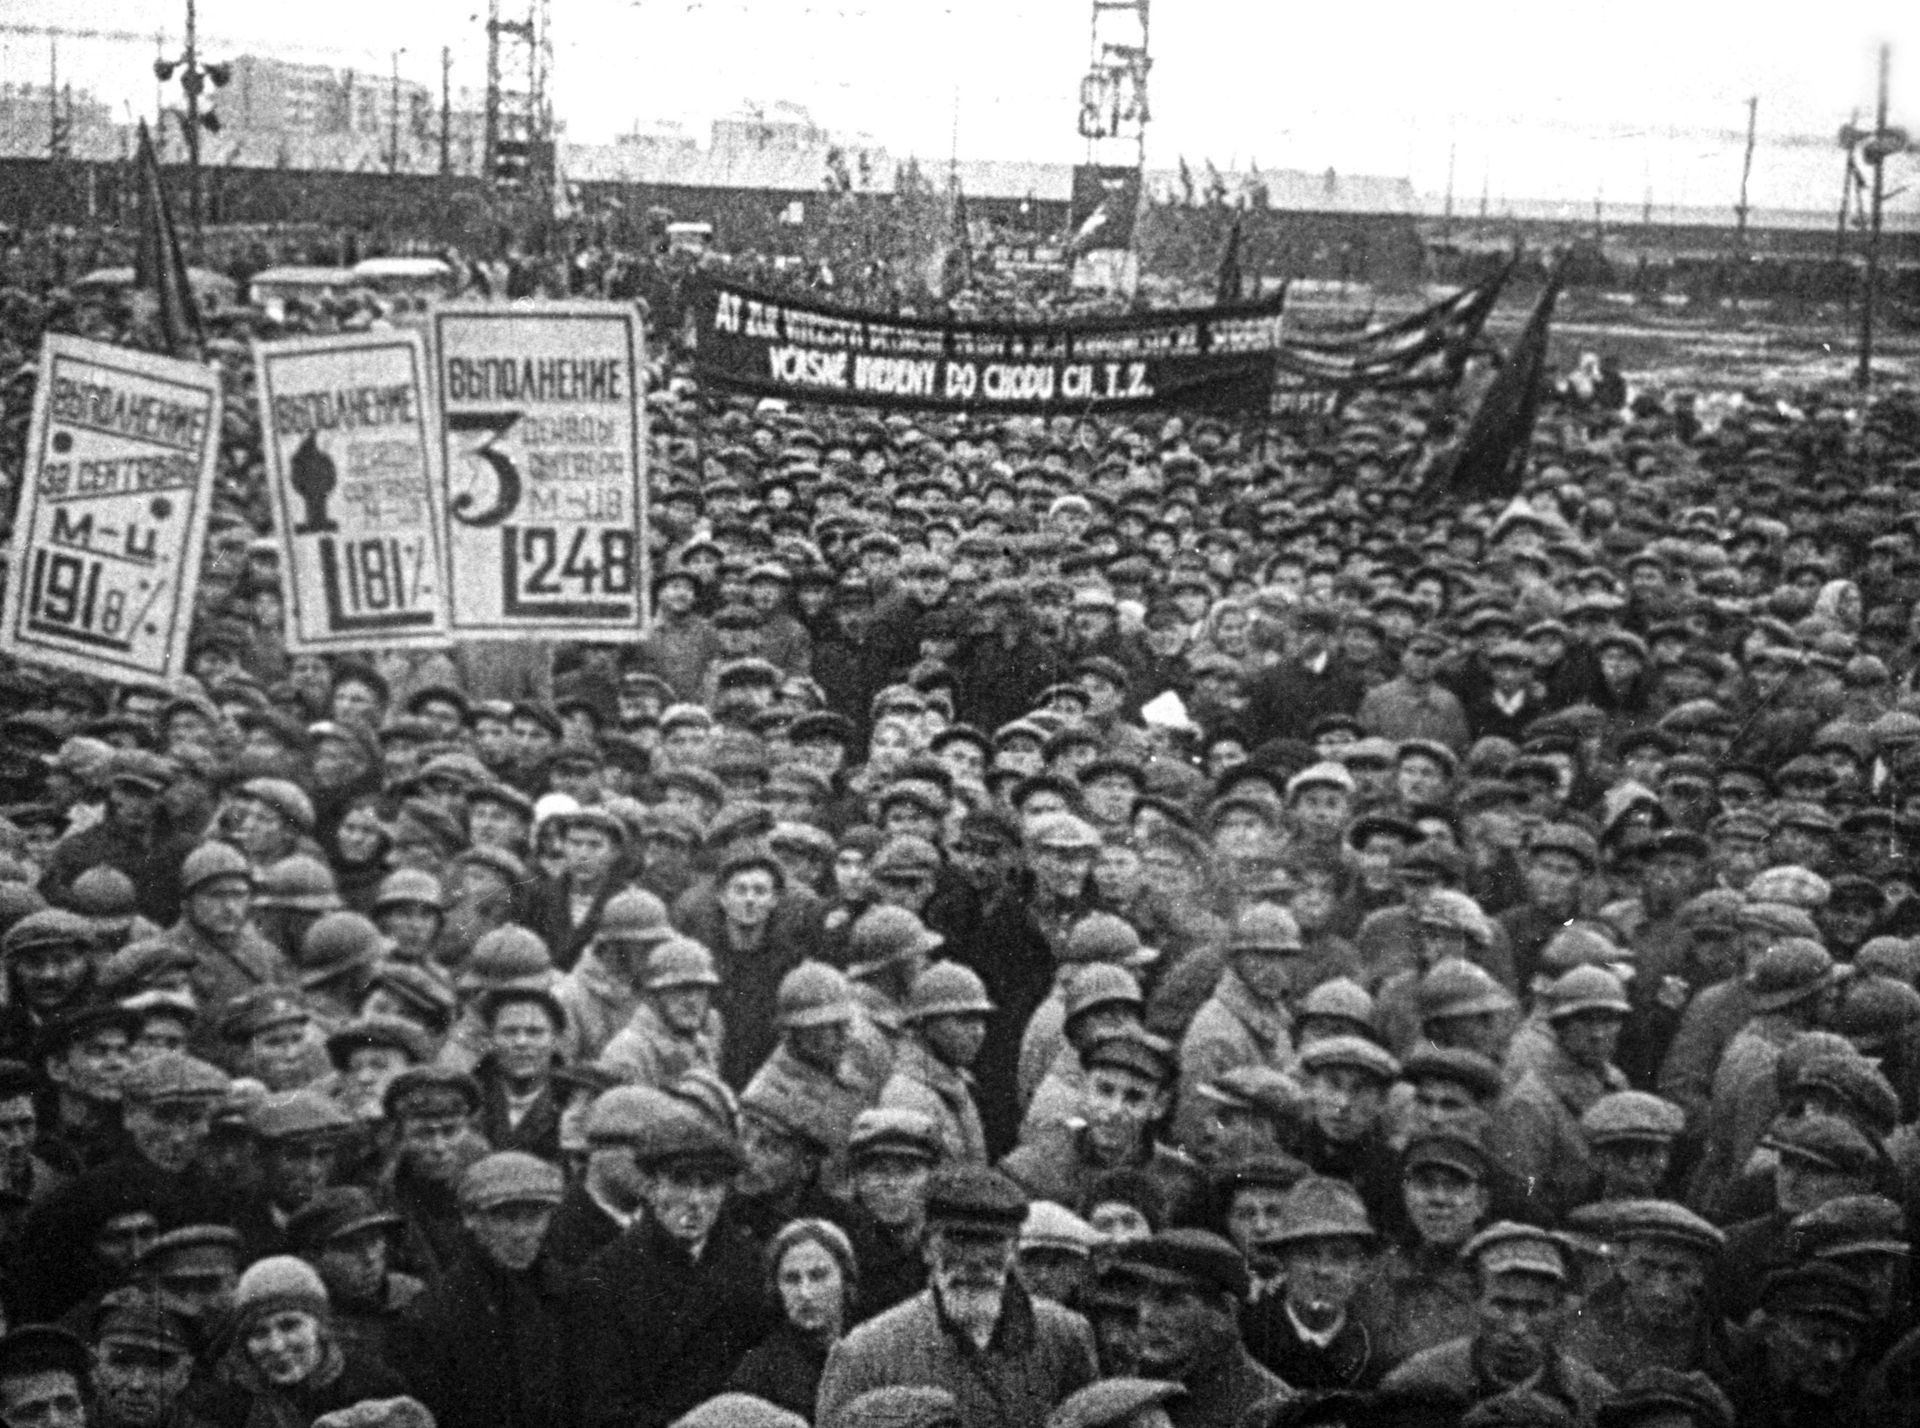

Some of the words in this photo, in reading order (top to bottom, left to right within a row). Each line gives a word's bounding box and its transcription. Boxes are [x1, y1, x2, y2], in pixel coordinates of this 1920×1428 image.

[449, 357, 621, 401] ВЫПОЛНЕНИЕ
[945, 361, 977, 399] DO
[53, 377, 205, 447] ВЫПОЛНЕНИЕ
